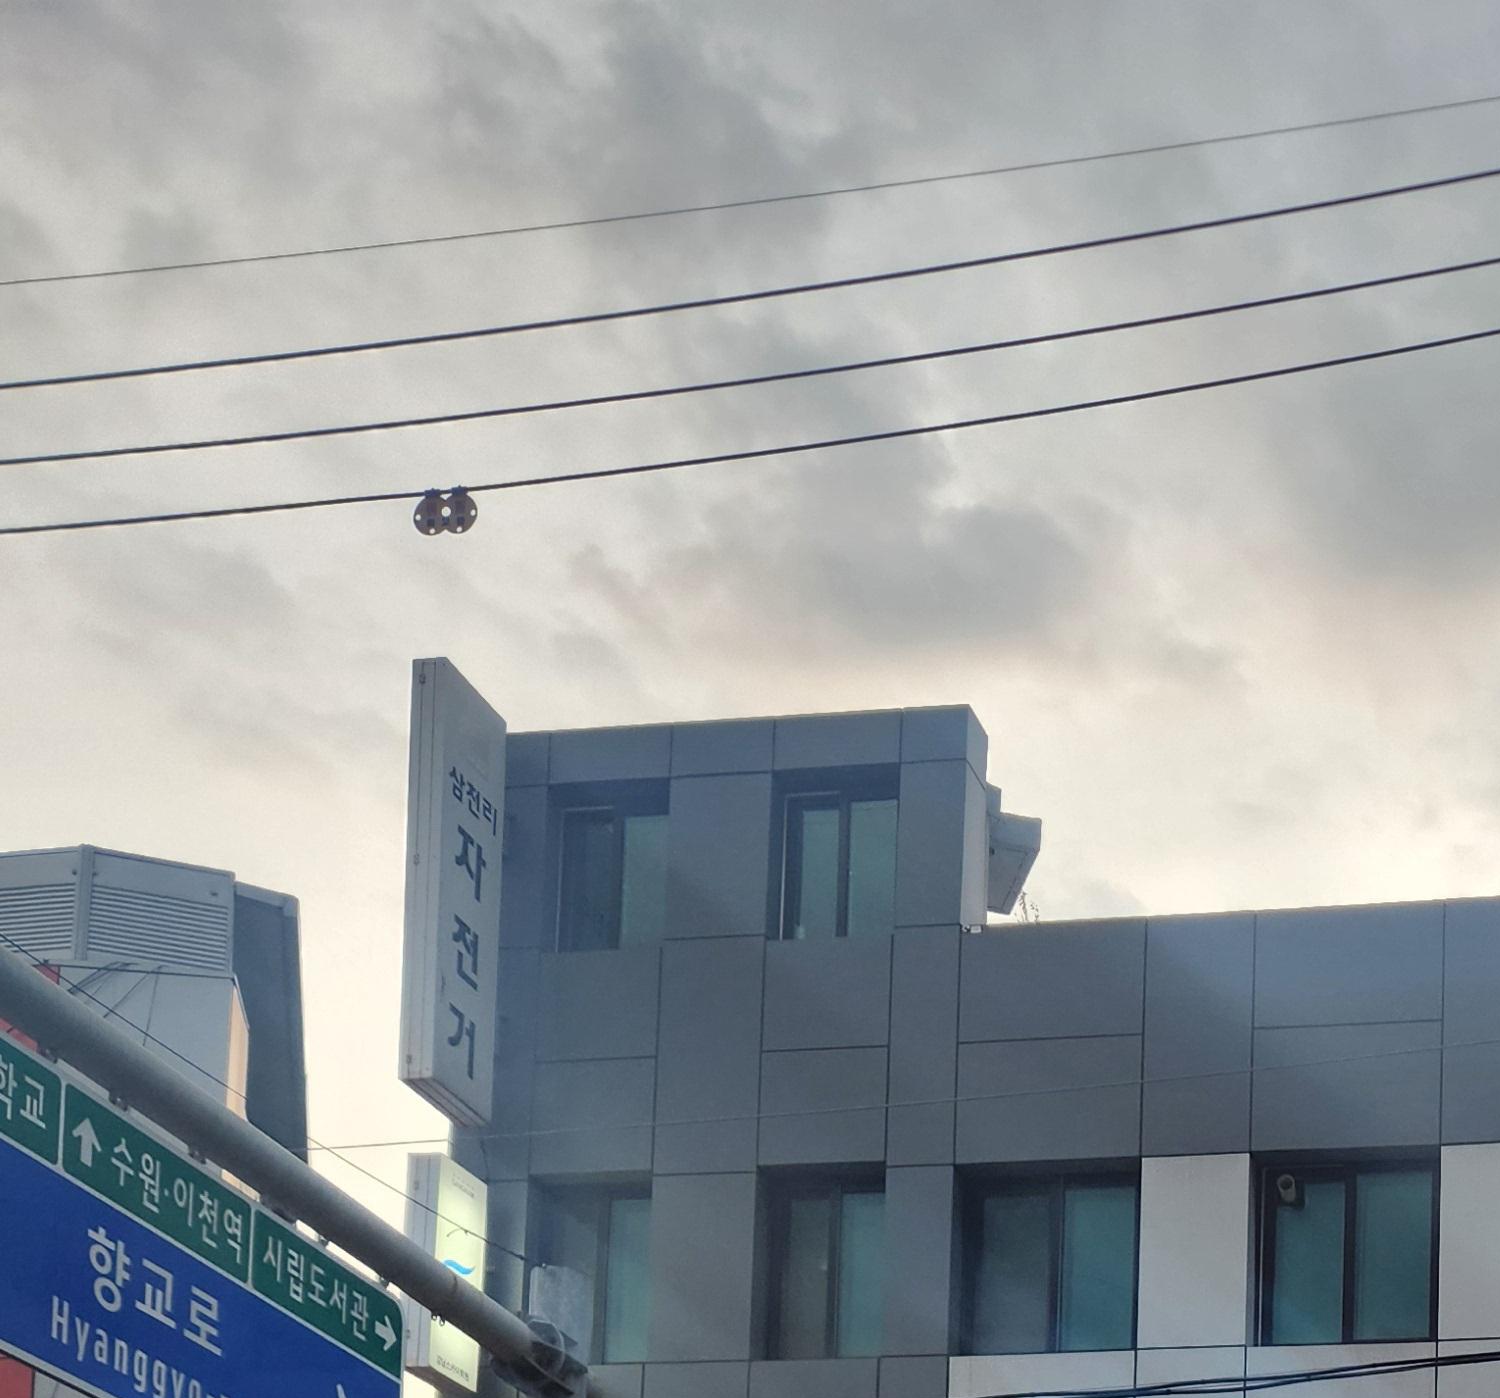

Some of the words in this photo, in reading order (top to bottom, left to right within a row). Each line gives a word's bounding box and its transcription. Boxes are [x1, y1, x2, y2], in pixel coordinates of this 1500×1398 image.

[448, 823, 487, 1080] 자전거
[87, 1226, 225, 1358] 향교로
[263, 1235, 369, 1341] 시립도서관
